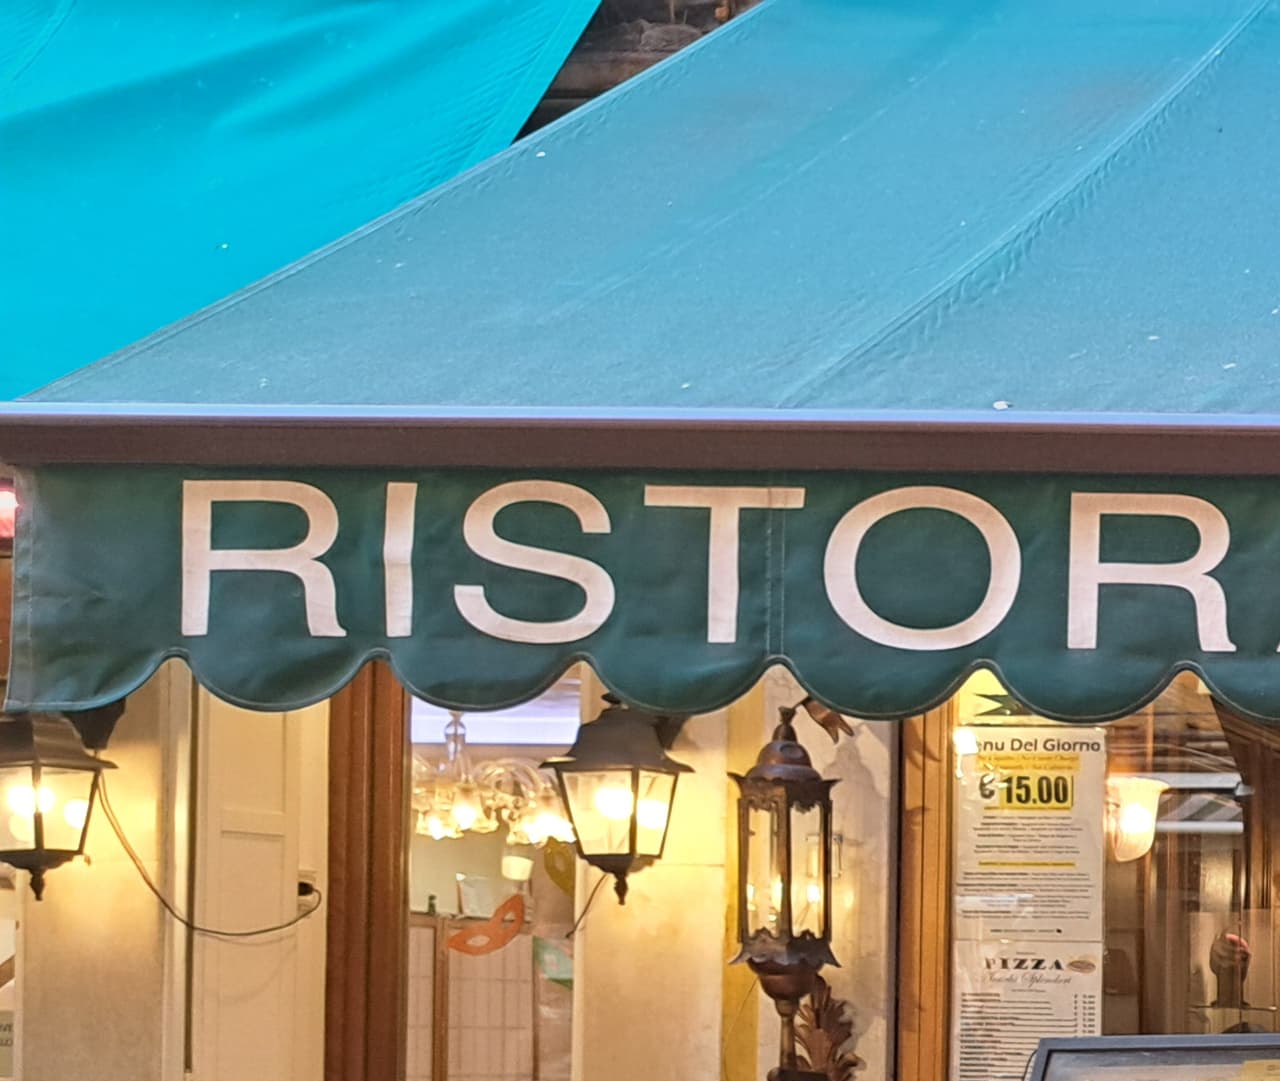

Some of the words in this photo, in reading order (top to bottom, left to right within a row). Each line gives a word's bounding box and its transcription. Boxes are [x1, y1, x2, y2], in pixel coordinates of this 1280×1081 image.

[1010, 738, 1038, 751] Del
[1042, 738, 1101, 752] Giorno
[1000, 775, 1069, 804] 15.00
[984, 957, 1065, 971] PIZZA
